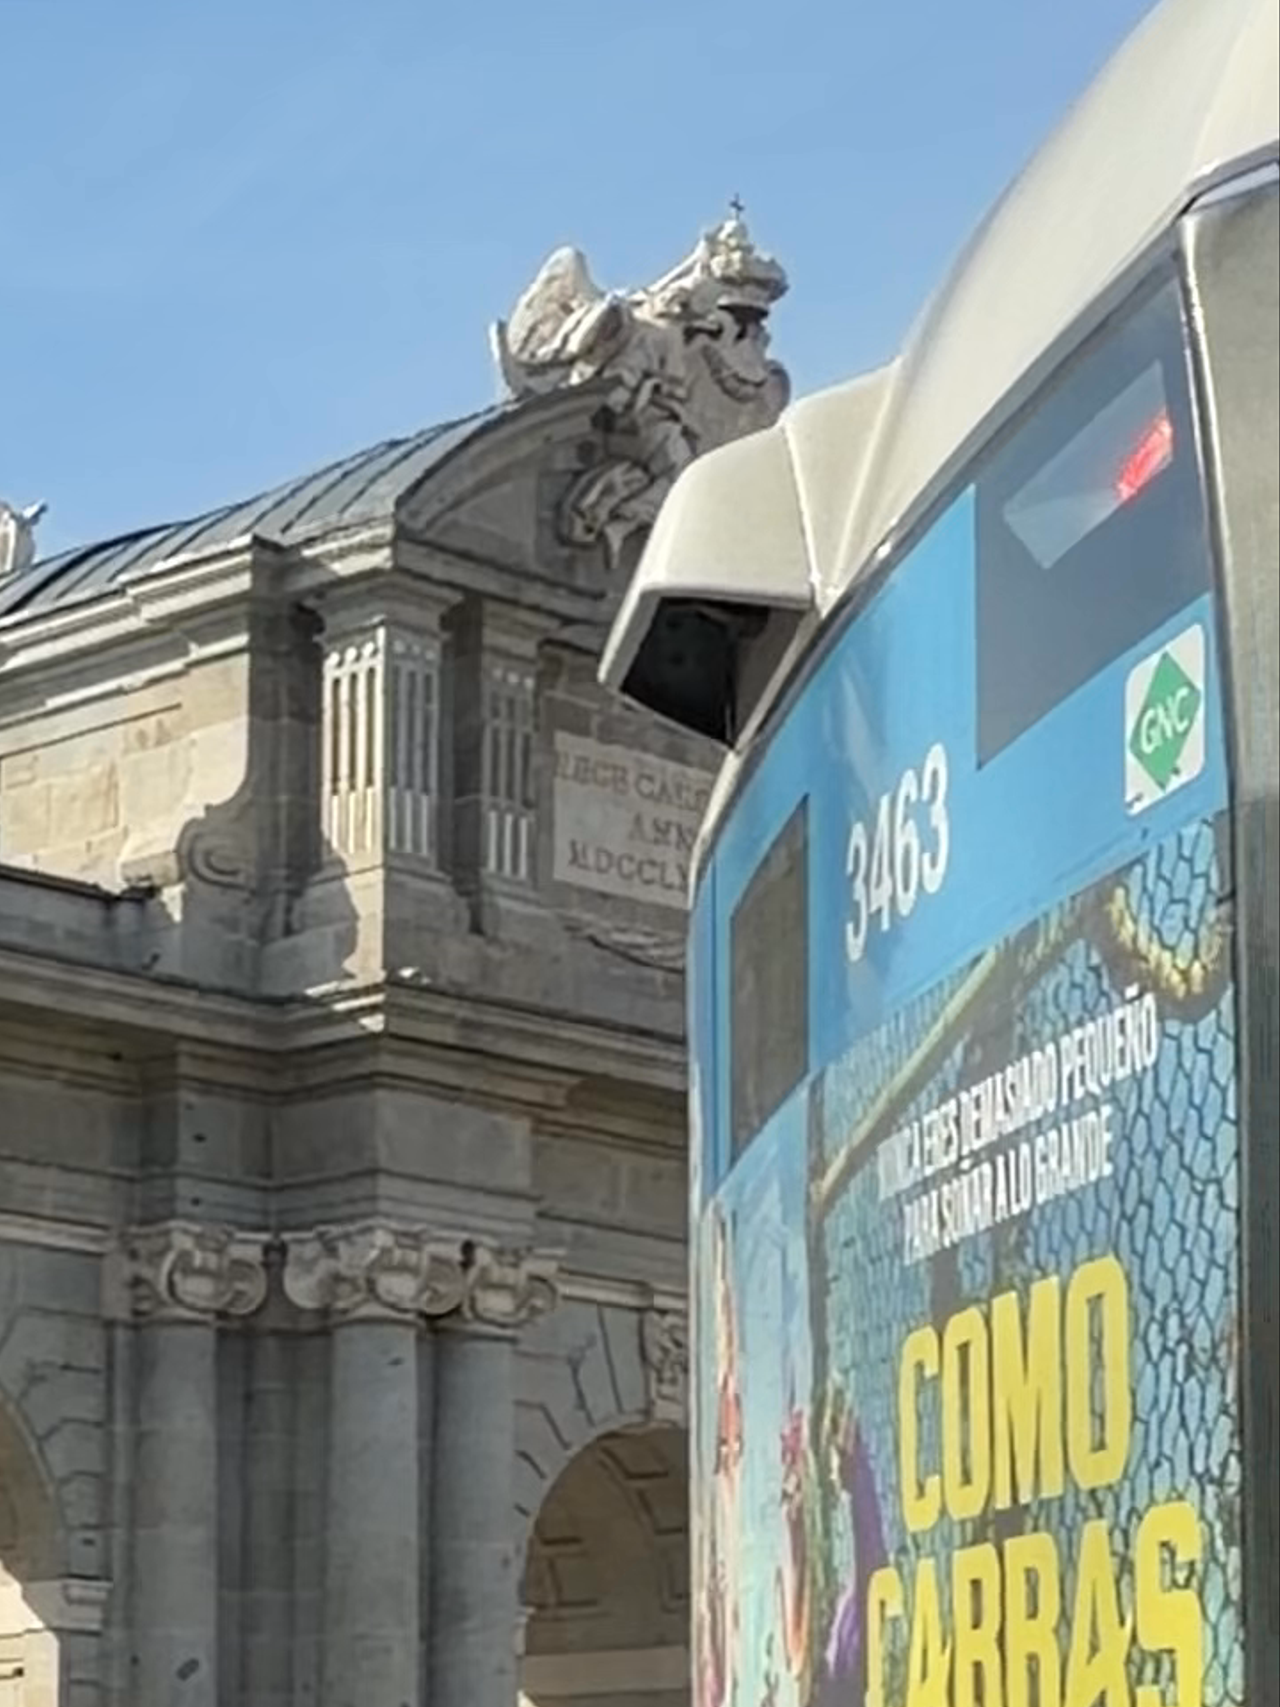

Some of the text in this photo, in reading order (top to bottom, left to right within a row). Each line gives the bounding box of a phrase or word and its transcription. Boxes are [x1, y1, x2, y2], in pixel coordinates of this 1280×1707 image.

[1141, 686, 1190, 754] GNC
[846, 742, 949, 962] 3463
[922, 1097, 959, 1178] ERES
[959, 1041, 1058, 1157] DEMASIADO
[1060, 983, 1156, 1106] PEQUEÑO
[994, 1153, 1008, 1223] A
[1009, 1142, 1032, 1216] LO
[1035, 1103, 1114, 1205] GRANDE
[898, 1255, 1131, 1533] COMO
